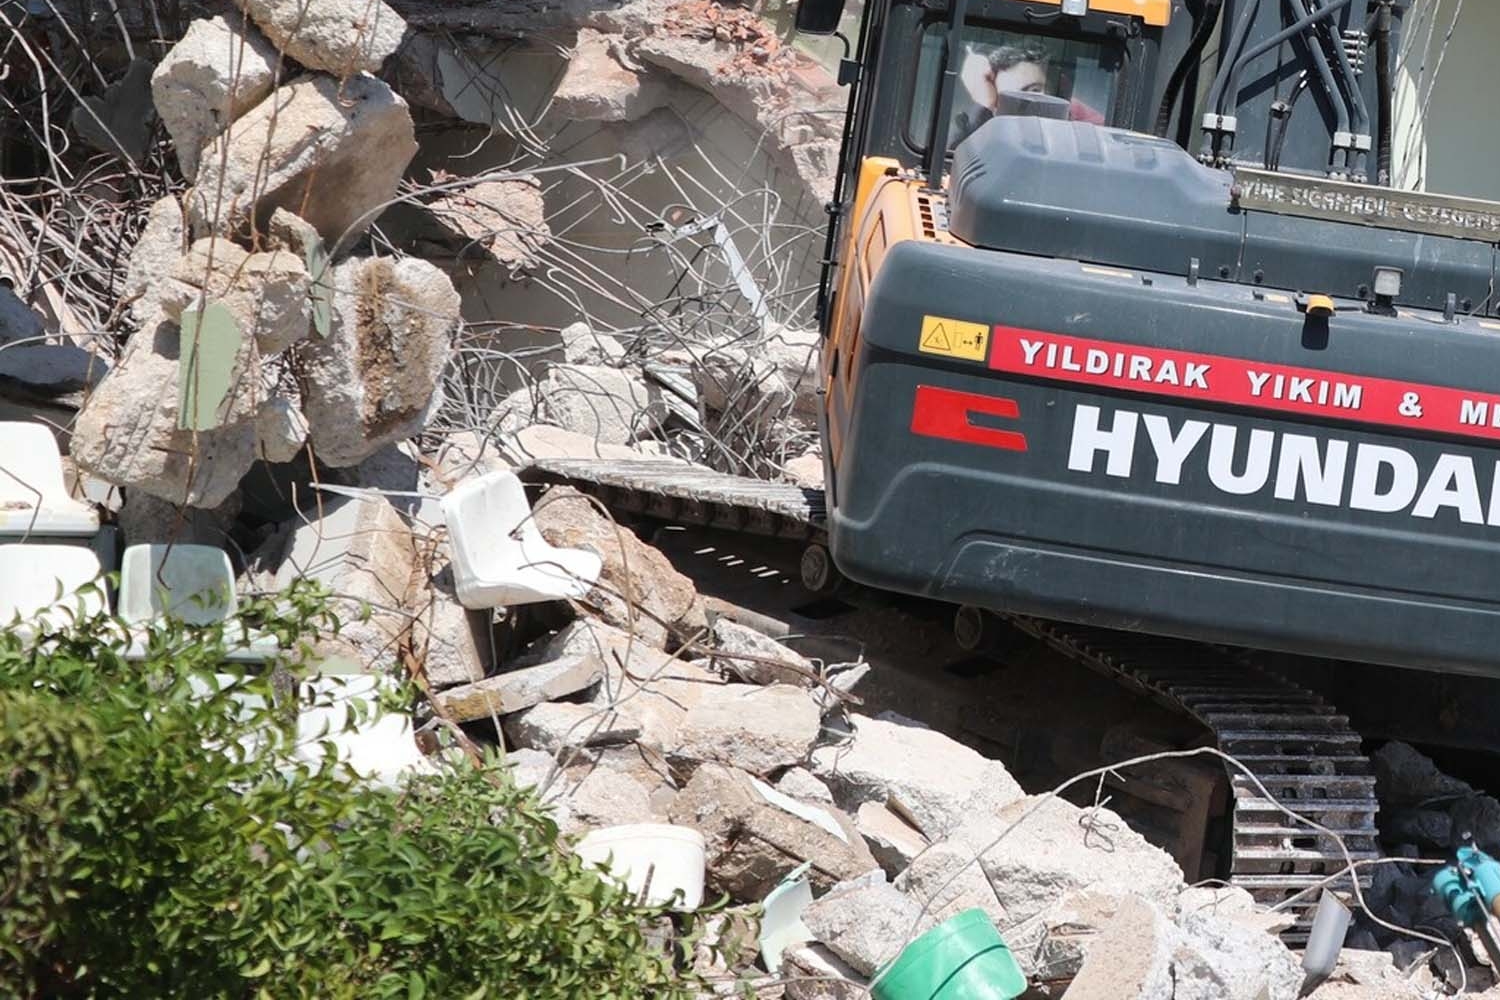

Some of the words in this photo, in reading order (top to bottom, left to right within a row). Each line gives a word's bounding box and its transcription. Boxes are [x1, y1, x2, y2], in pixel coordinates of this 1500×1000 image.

[1019, 338, 1211, 389] YILDIRAK
[1247, 370, 1362, 409] YIKIM
[1398, 391, 1423, 418] &
